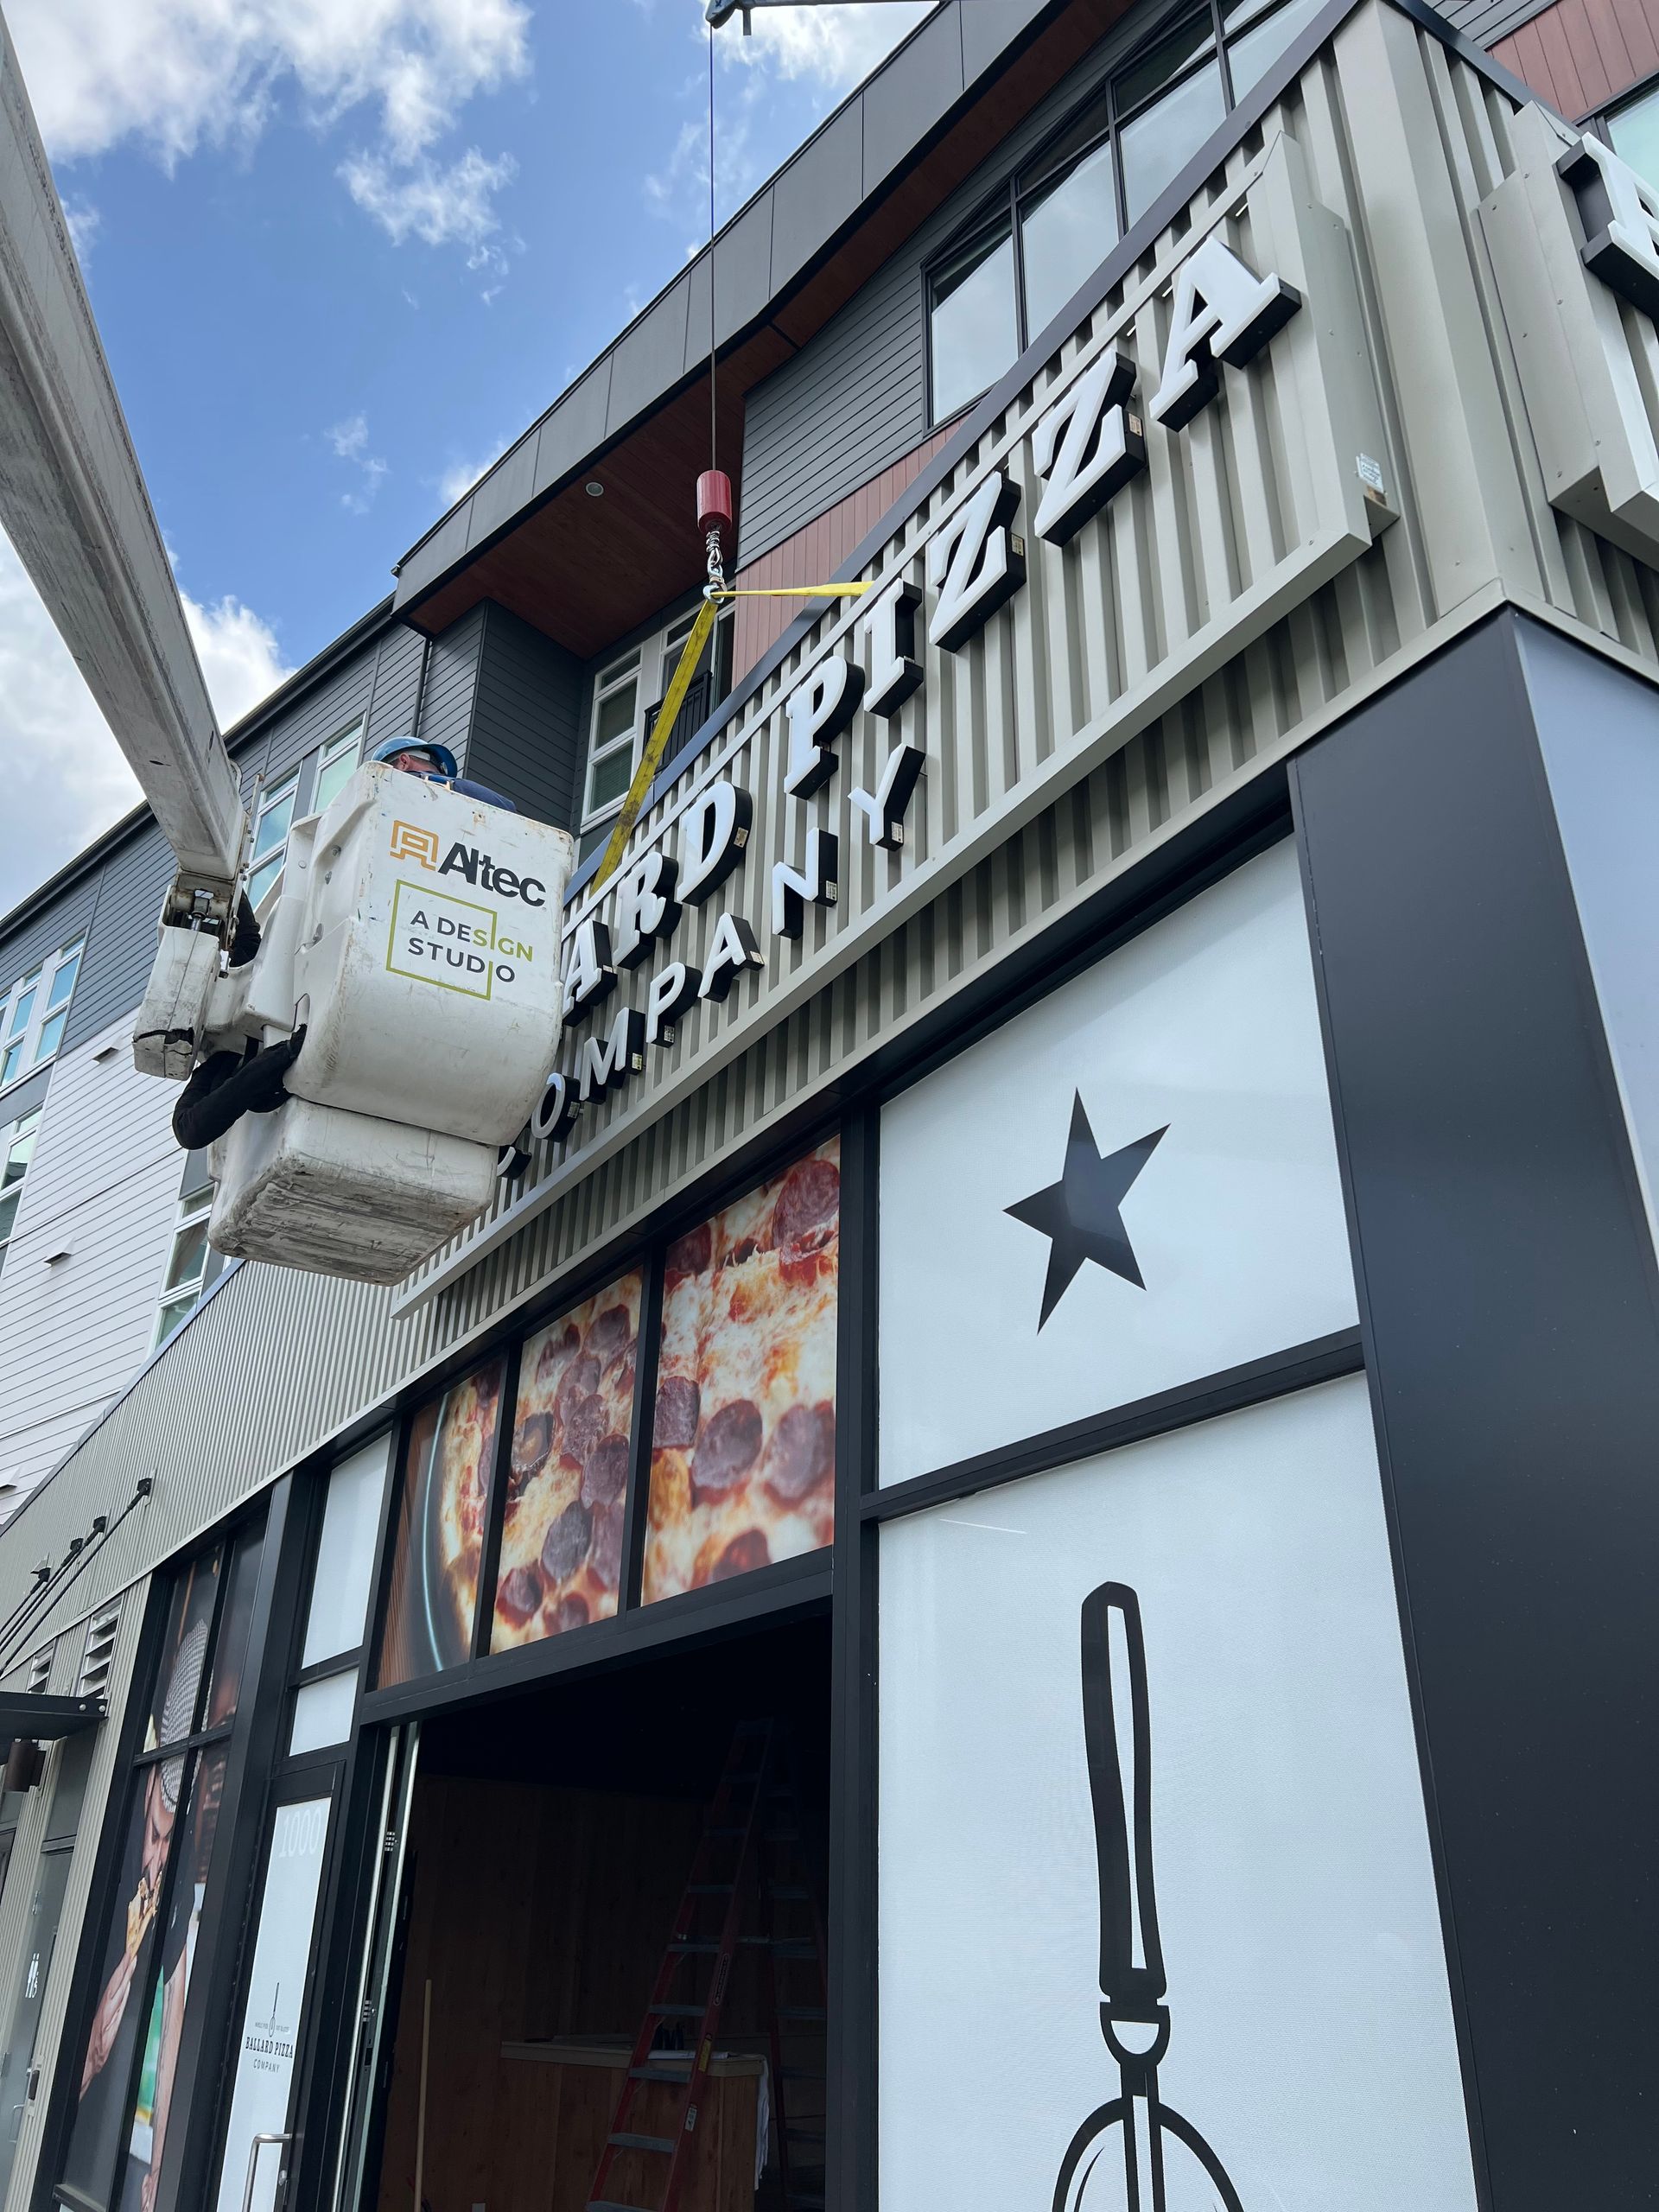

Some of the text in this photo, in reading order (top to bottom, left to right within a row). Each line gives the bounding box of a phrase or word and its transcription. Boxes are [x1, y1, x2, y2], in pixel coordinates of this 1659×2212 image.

[784, 235, 1302, 799] PIZZA
[437, 841, 547, 908] Altec
[407, 937, 516, 983] STUDIO
[410, 909, 534, 963] A DESIGN
[498, 742, 925, 1179] OMPANY
[278, 1805, 322, 1859] 1000
[245, 2037, 293, 2058] BALLARD PIZZA
[253, 2059, 280, 2073] COMPANY
